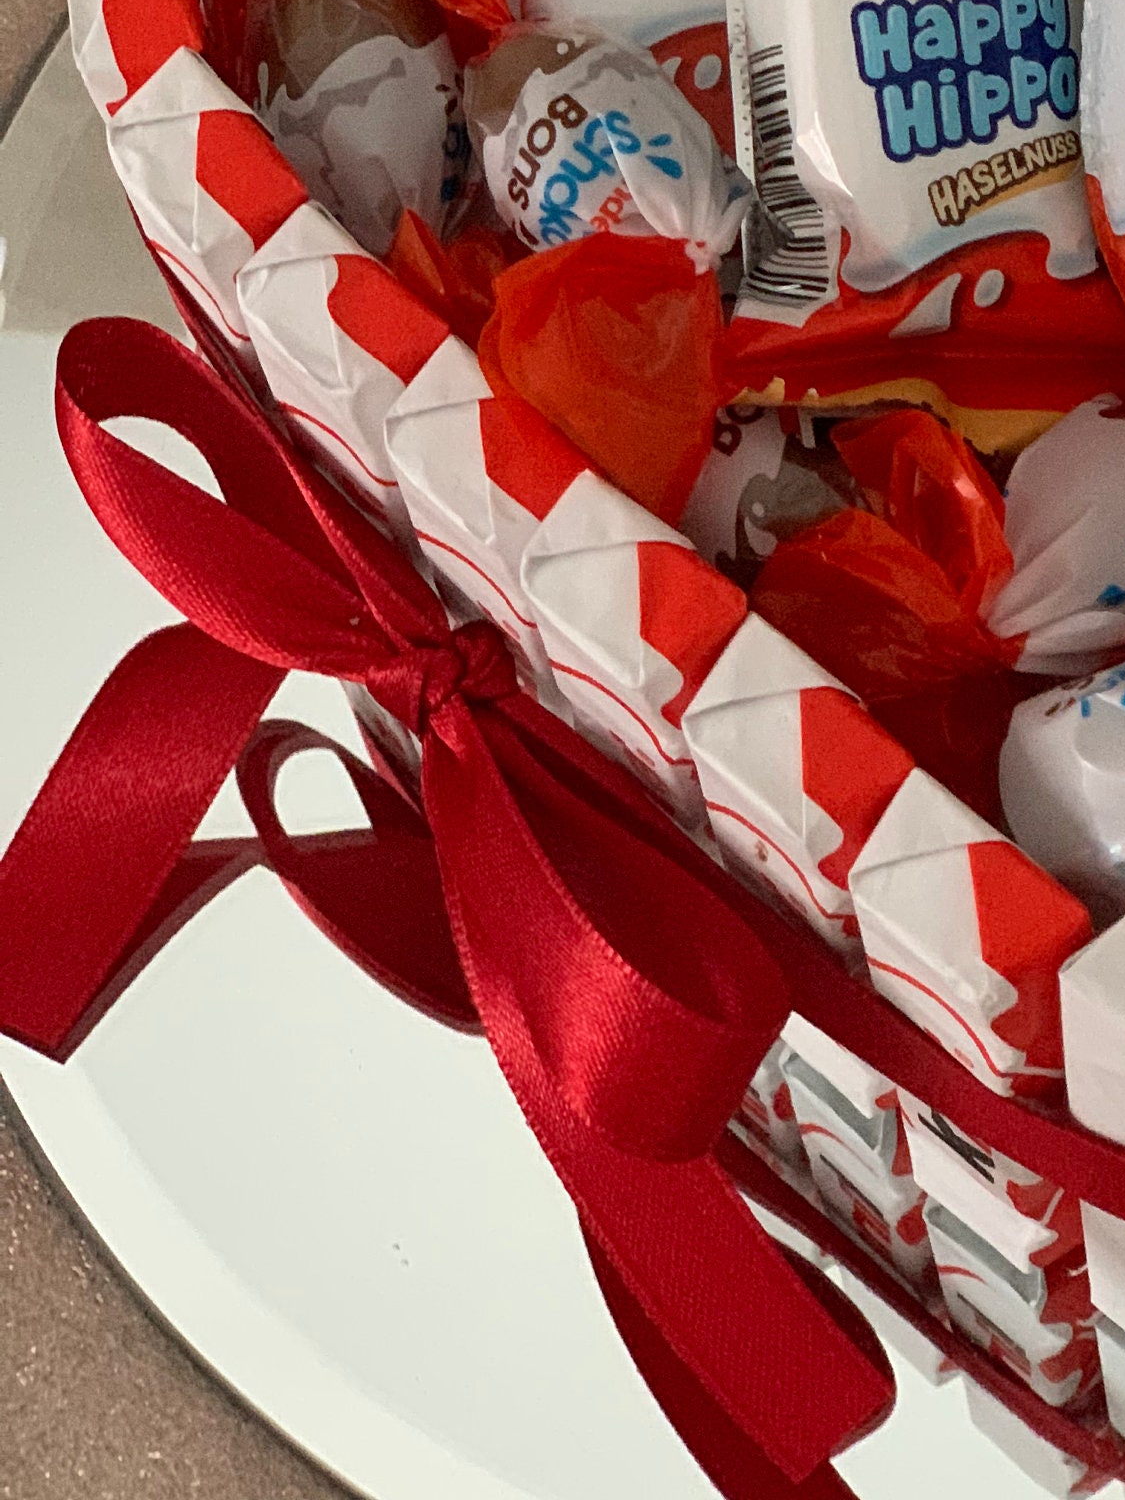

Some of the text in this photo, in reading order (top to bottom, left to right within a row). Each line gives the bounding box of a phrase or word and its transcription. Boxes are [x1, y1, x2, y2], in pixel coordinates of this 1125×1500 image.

[508, 93, 588, 211] Bons
[880, 52, 1080, 160] Hippo
[928, 130, 1083, 227] HASELNUSS
